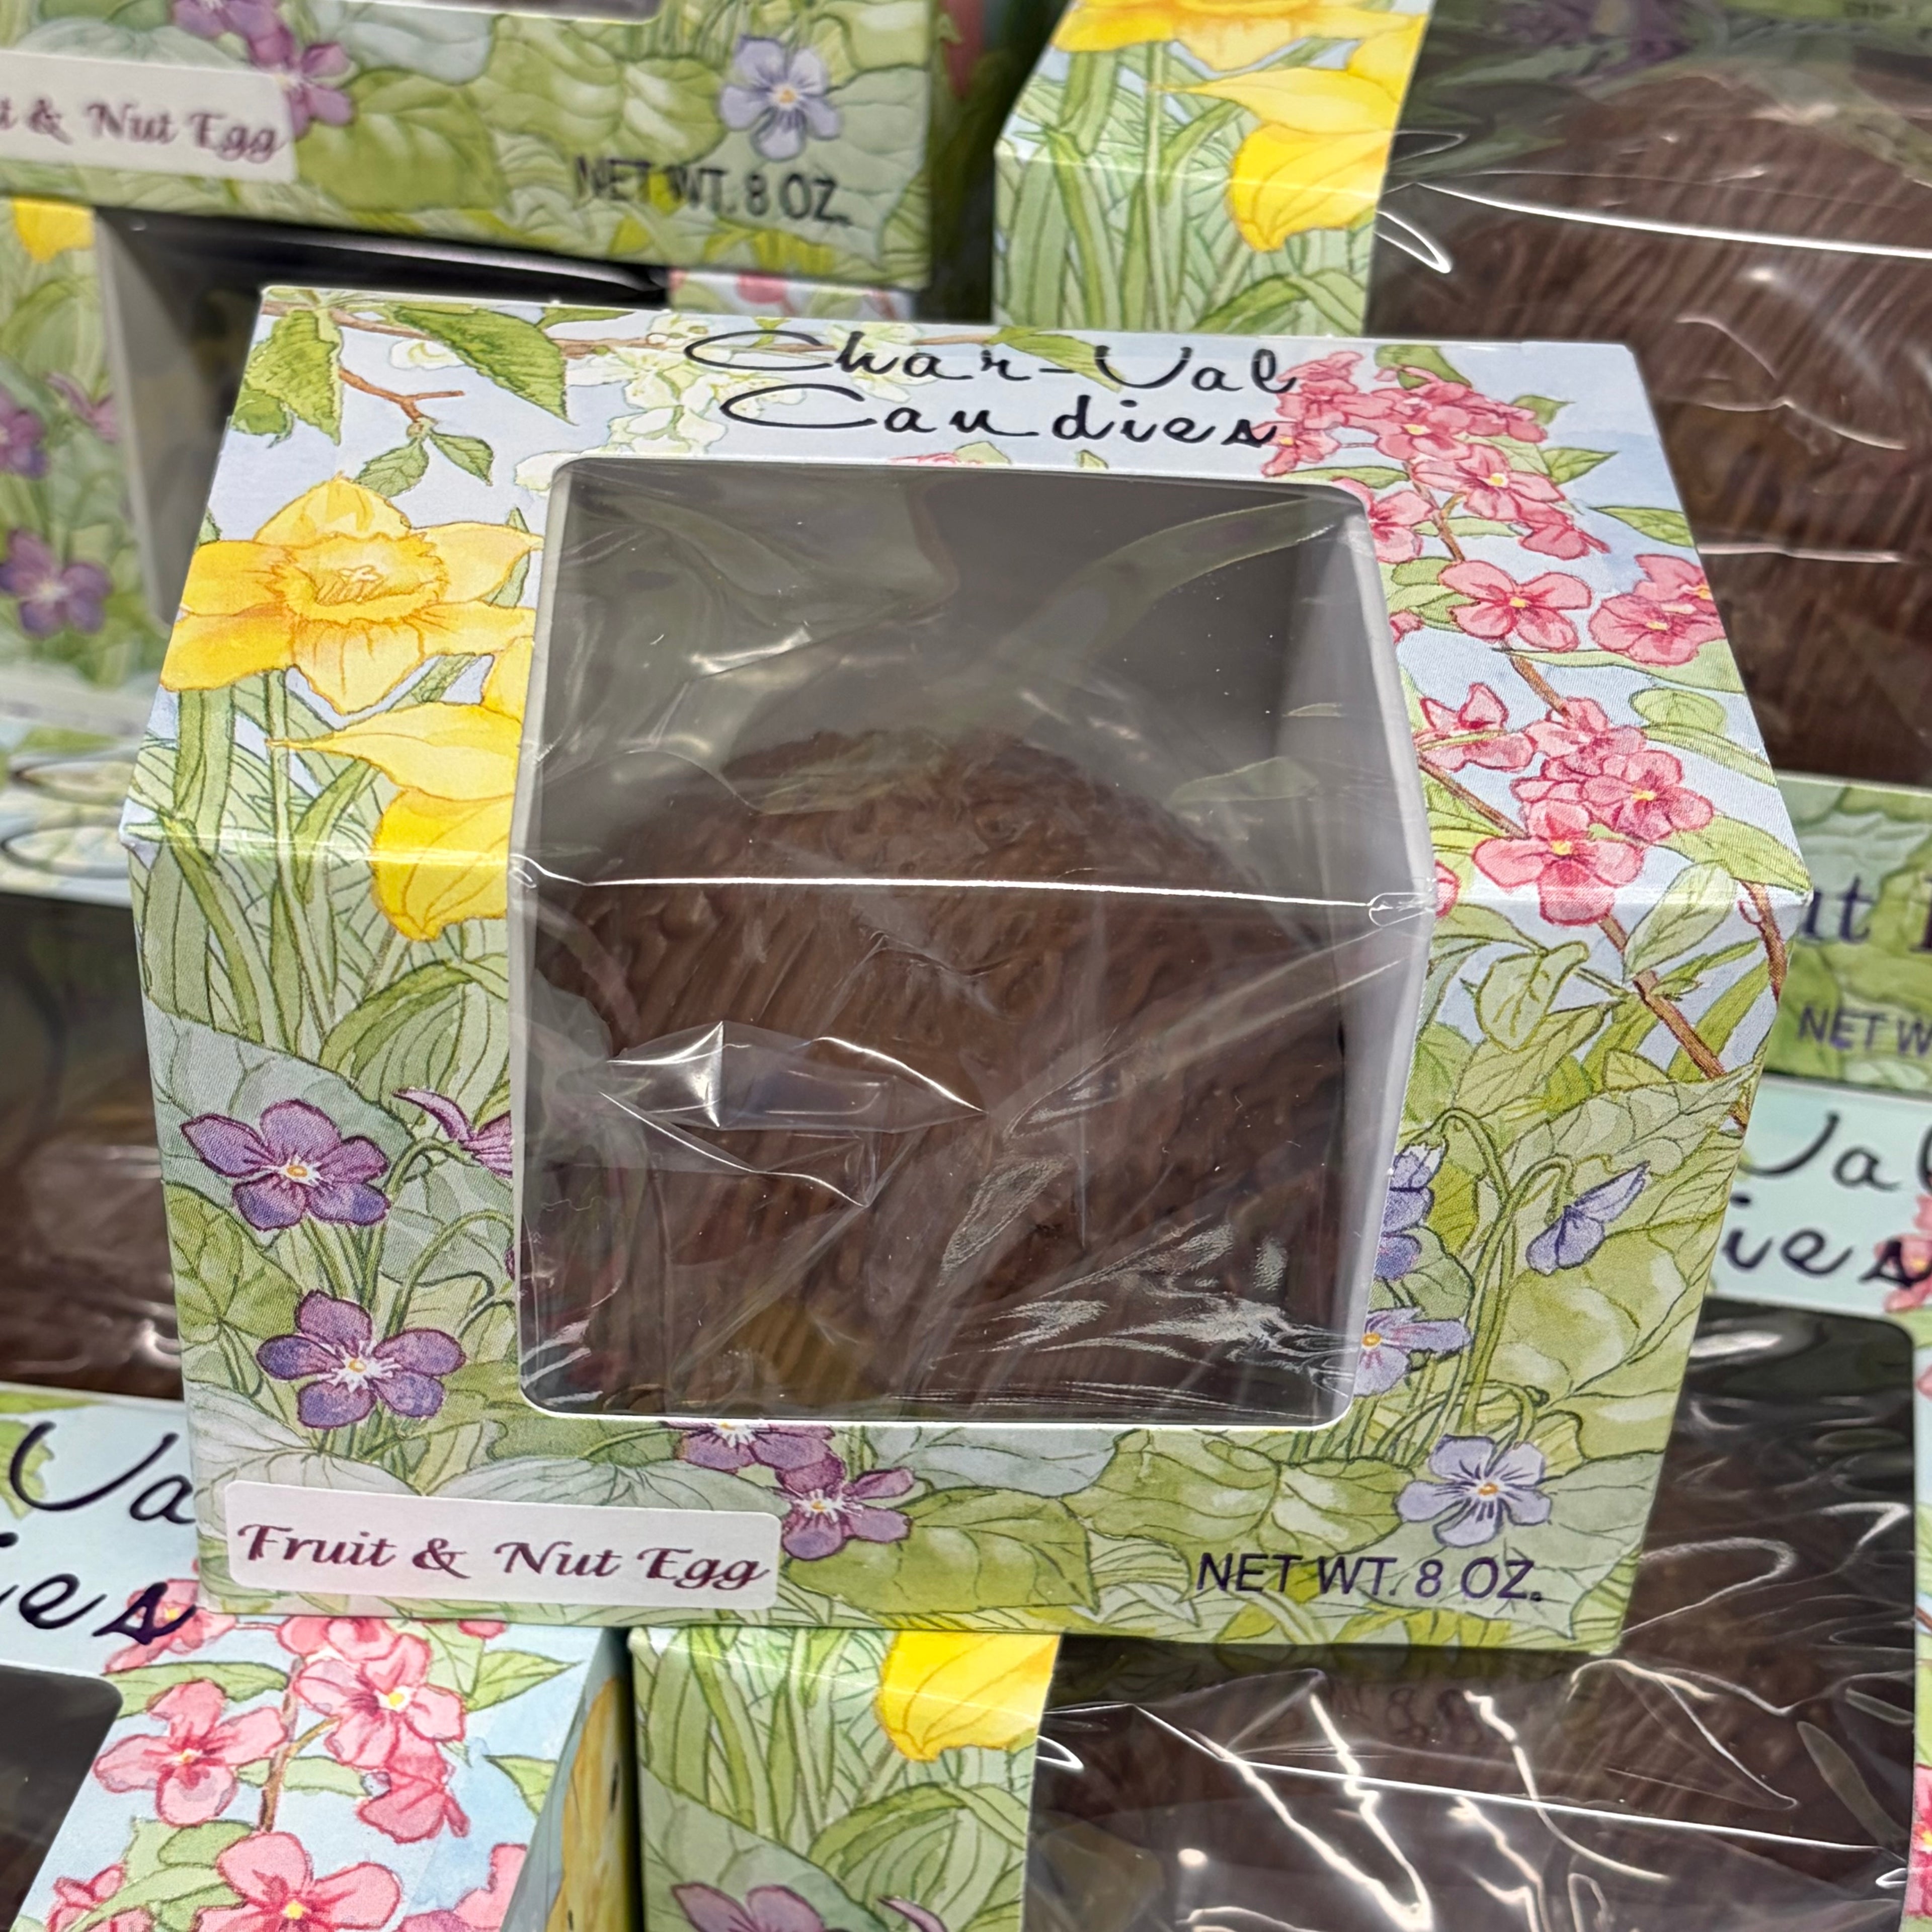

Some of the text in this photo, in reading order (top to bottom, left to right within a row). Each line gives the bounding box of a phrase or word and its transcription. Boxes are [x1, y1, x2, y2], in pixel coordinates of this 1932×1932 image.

[25, 97, 74, 145] &
[87, 101, 178, 145] Nut
[188, 113, 285, 164] Egg
[574, 155, 653, 202] NET
[743, 174, 770, 216] 8
[719, 383, 1278, 448] Candies
[1797, 1004, 1888, 1052] NET
[236, 1523, 770, 1591] Fruit & Nut Egg
[1196, 1552, 1543, 1603] NET WT. 8 OZ.
